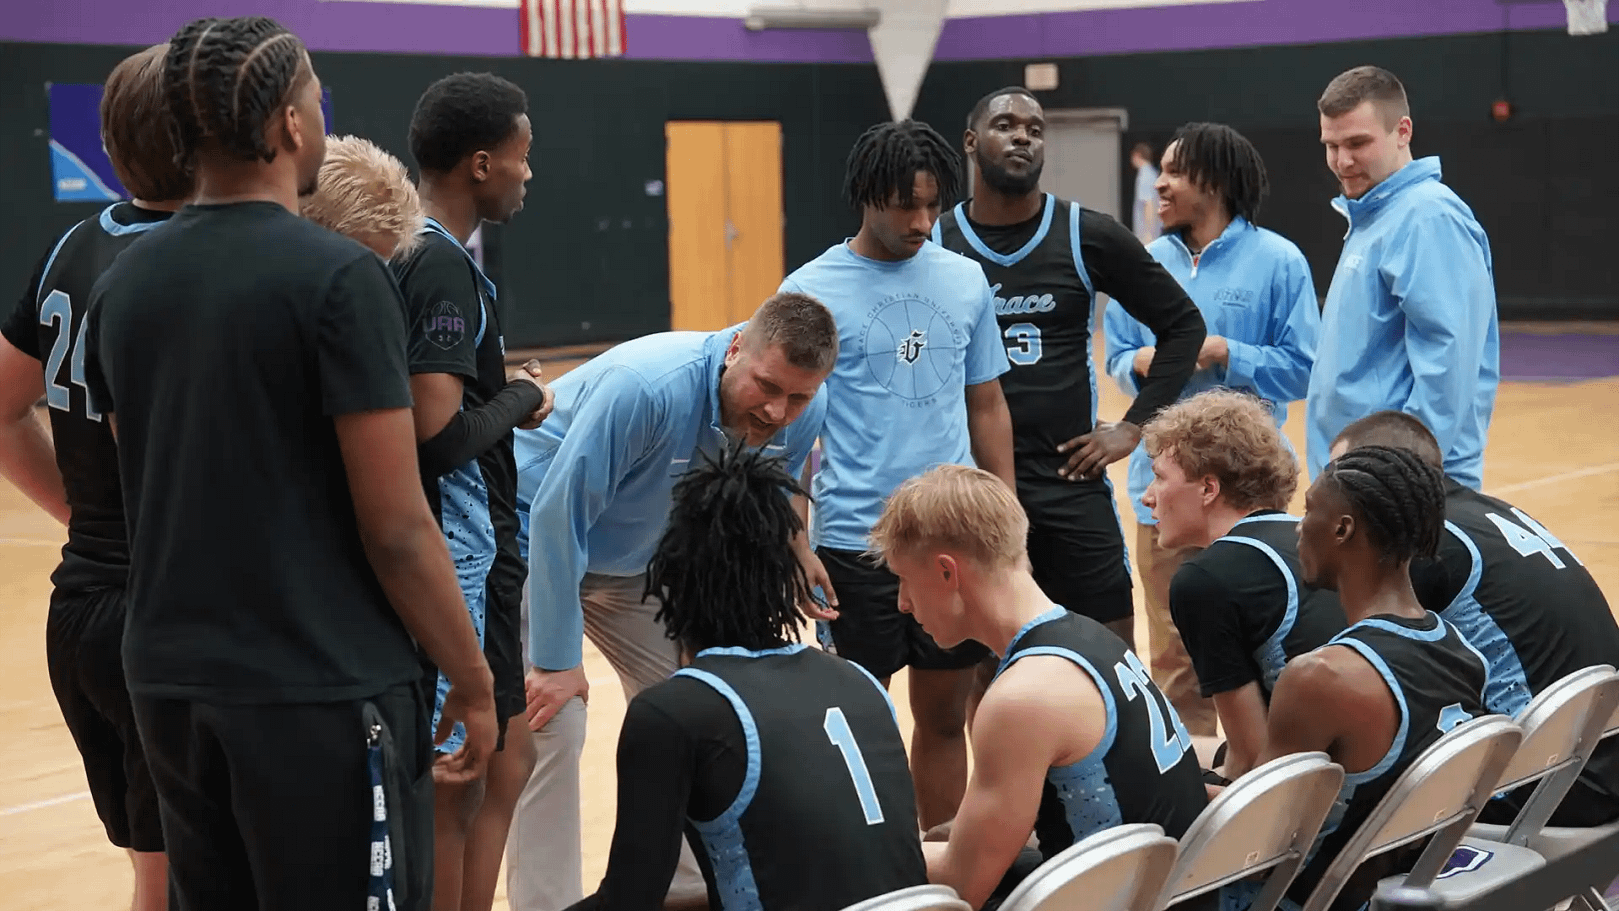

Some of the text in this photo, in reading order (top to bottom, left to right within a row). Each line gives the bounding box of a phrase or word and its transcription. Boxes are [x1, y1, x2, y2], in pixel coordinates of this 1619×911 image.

[923, 296, 963, 347] UNIVERSIT
[990, 282, 1057, 315] race
[1484, 507, 1584, 571] 44
[823, 706, 885, 826] 1
